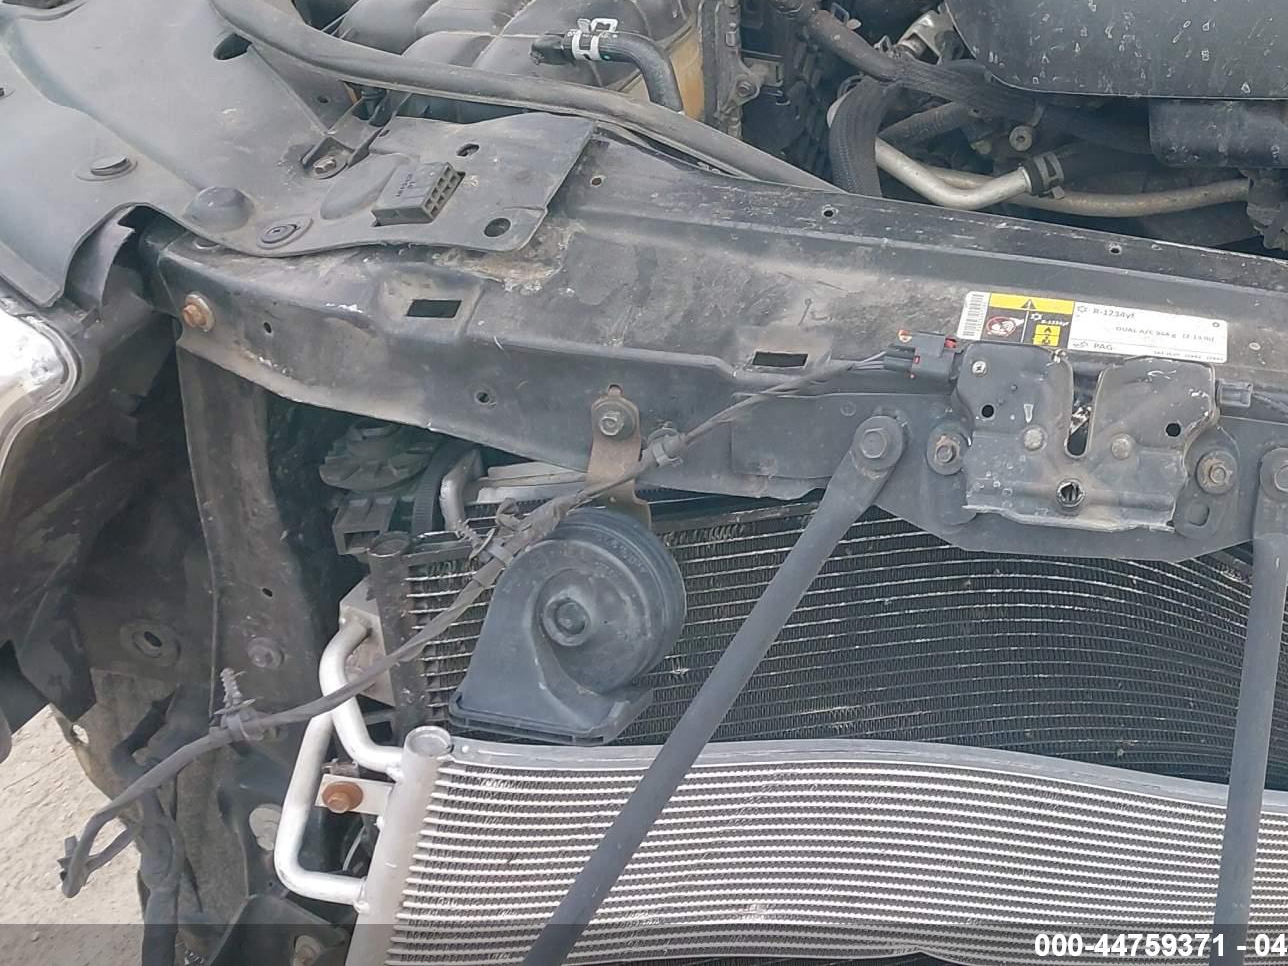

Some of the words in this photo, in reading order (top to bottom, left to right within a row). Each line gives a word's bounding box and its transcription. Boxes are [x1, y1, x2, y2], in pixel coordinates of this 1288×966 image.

[1093, 308, 1135, 320] R-1234yf
[1115, 326, 1138, 334] DUAL
[1093, 342, 1113, 351] PAG
